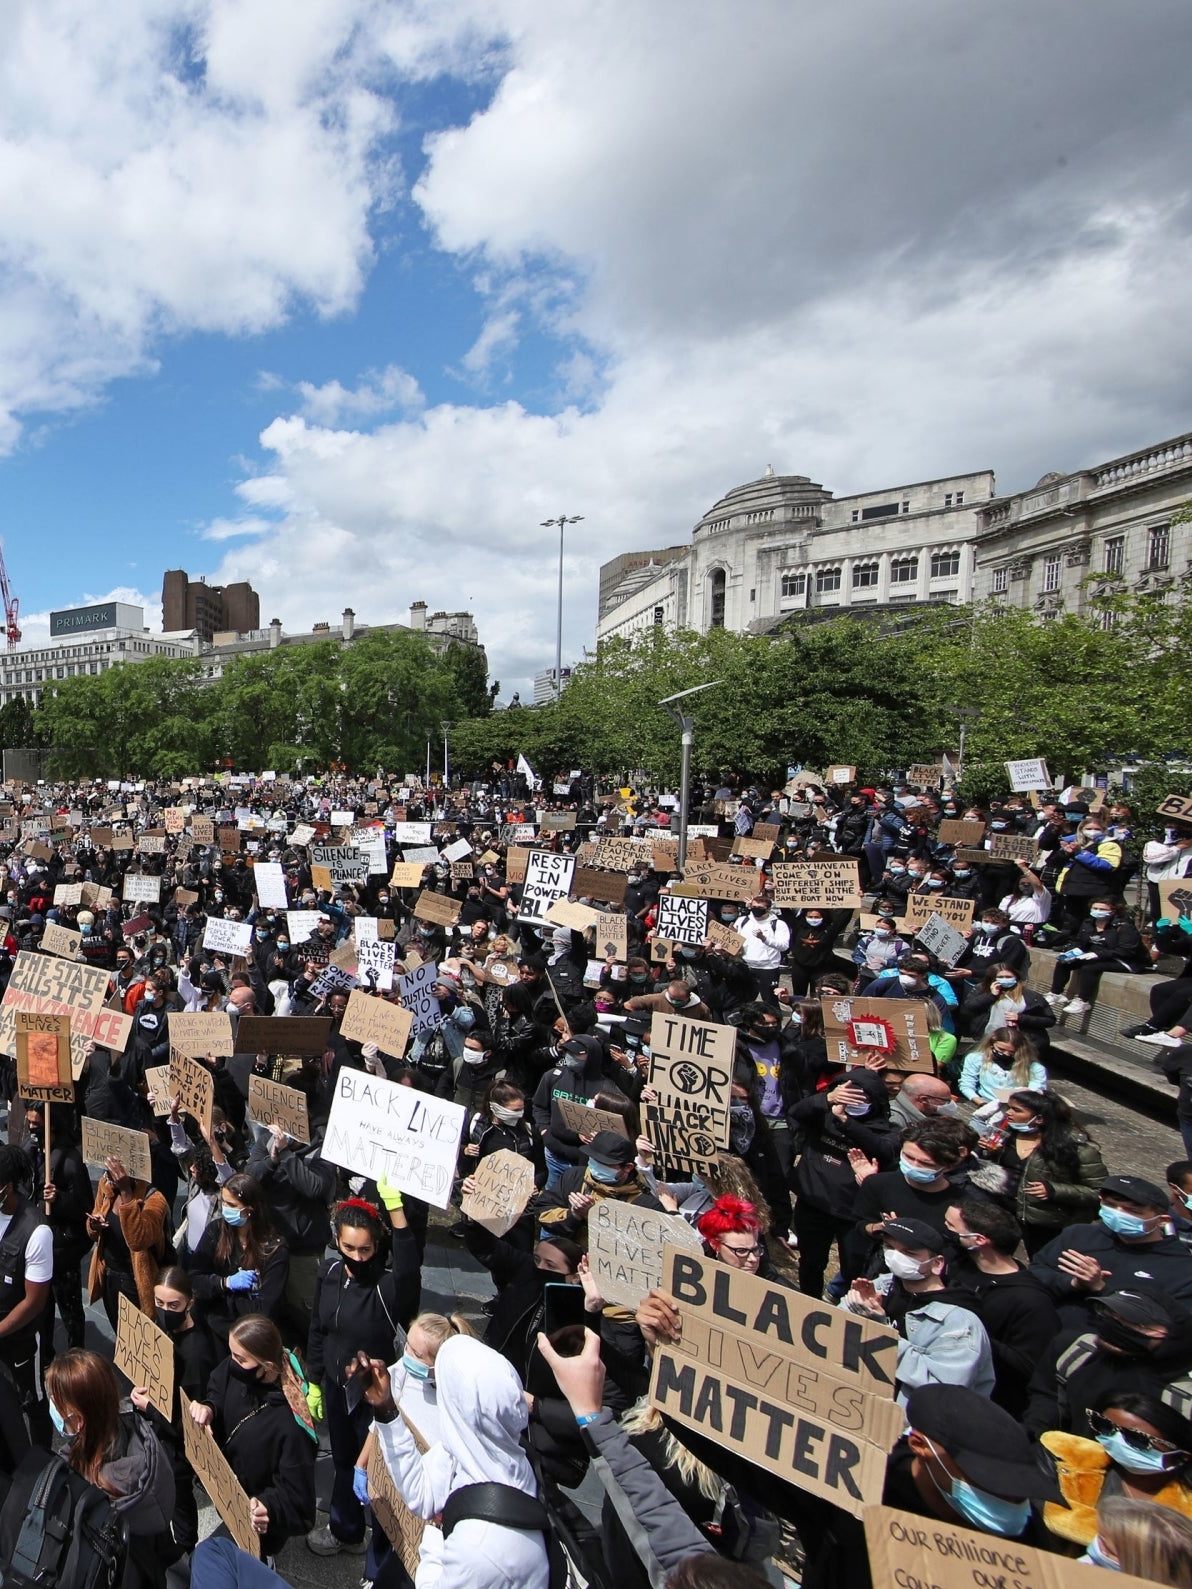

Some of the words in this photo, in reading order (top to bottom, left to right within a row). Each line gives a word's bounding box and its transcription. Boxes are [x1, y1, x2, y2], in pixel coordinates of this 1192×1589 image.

[56, 611, 108, 628] PRIMARK
[598, 838, 636, 850] BLACK
[995, 842, 1034, 854] LIVES
[996, 835, 1036, 846] BLACK
[313, 847, 358, 862] SILENCE
[596, 845, 644, 860] BEAUTIFUL
[991, 849, 1034, 862] MATTER
[532, 853, 574, 874] REST
[774, 863, 790, 871] WE
[792, 863, 811, 871] MAY
[839, 862, 857, 870] ALL
[536, 871, 560, 886] IN
[684, 863, 714, 876] BLACK
[719, 872, 748, 887] LIVES
[776, 871, 801, 879] COME
[823, 871, 841, 879] ON
[777, 879, 825, 887] DIFFERENT
[829, 879, 854, 887] SHIPS
[775, 887, 791, 895] BUT
[825, 887, 835, 895] IN
[836, 887, 855, 895] THE
[660, 896, 706, 915] BLACK
[912, 896, 930, 907] WE
[934, 899, 971, 911] STAND
[209, 920, 227, 930] MAKE
[228, 923, 241, 932] THE
[600, 915, 625, 925] BLACK
[659, 912, 705, 930] LIVES
[946, 910, 967, 922] YOU
[600, 924, 624, 933] LIVES
[600, 932, 624, 940] MATTER
[658, 923, 704, 944] MATTER
[360, 939, 394, 952] BLACK
[721, 932, 741, 948] LIVES
[934, 934, 951, 955] NEVER
[359, 958, 393, 971] MATTER
[360, 950, 393, 961] LIVES
[18, 953, 51, 977] THE
[52, 961, 107, 993] STATE
[321, 970, 350, 989] RACE
[329, 965, 353, 982] ONE
[405, 967, 426, 989] NO
[9, 970, 52, 997] CALLS
[52, 983, 94, 1010] ITS
[402, 981, 437, 1009] JUSTICE
[4, 990, 34, 1011] OWN
[409, 998, 431, 1018] NO
[21, 1014, 60, 1024] BLACK
[26, 1022, 61, 1031] LIVES
[665, 1019, 718, 1059] TIME
[158, 1066, 170, 1079] UK
[170, 1047, 181, 1063] AN
[183, 1058, 212, 1085] ATTAC
[169, 1065, 181, 1077] ONE
[185, 1074, 194, 1085] IS
[196, 1083, 207, 1094] AN
[648, 1052, 730, 1105] FOR
[20, 1086, 73, 1101] MATTER
[193, 1092, 207, 1106] ON
[252, 1080, 306, 1114] SILENCE
[270, 1103, 279, 1115] IS
[340, 1076, 401, 1118] BLACK
[407, 1100, 459, 1144] LIVES
[646, 1106, 713, 1132] BLACK
[251, 1107, 306, 1139] VIOLENCE
[85, 1122, 129, 1146] BLACK
[359, 1120, 382, 1136] HAVE
[387, 1130, 425, 1149] ALWAYS
[646, 1120, 689, 1158] LIVES
[87, 1137, 122, 1155] LIVES
[326, 1125, 449, 1196] MATTERED
[486, 1154, 528, 1186] BLACK
[653, 1152, 721, 1180] MATTER
[477, 1173, 514, 1203] LIVES
[467, 1187, 513, 1224] MATTER
[598, 1205, 671, 1244] BLACK
[120, 1296, 162, 1359] BLACK
[671, 1252, 899, 1386] BLACK
[119, 1319, 161, 1380] LIVES
[115, 1340, 169, 1415] MATTER
[672, 1313, 864, 1430] LIVES
[655, 1354, 864, 1502] MATTER
[889, 1521, 932, 1551] OUR
